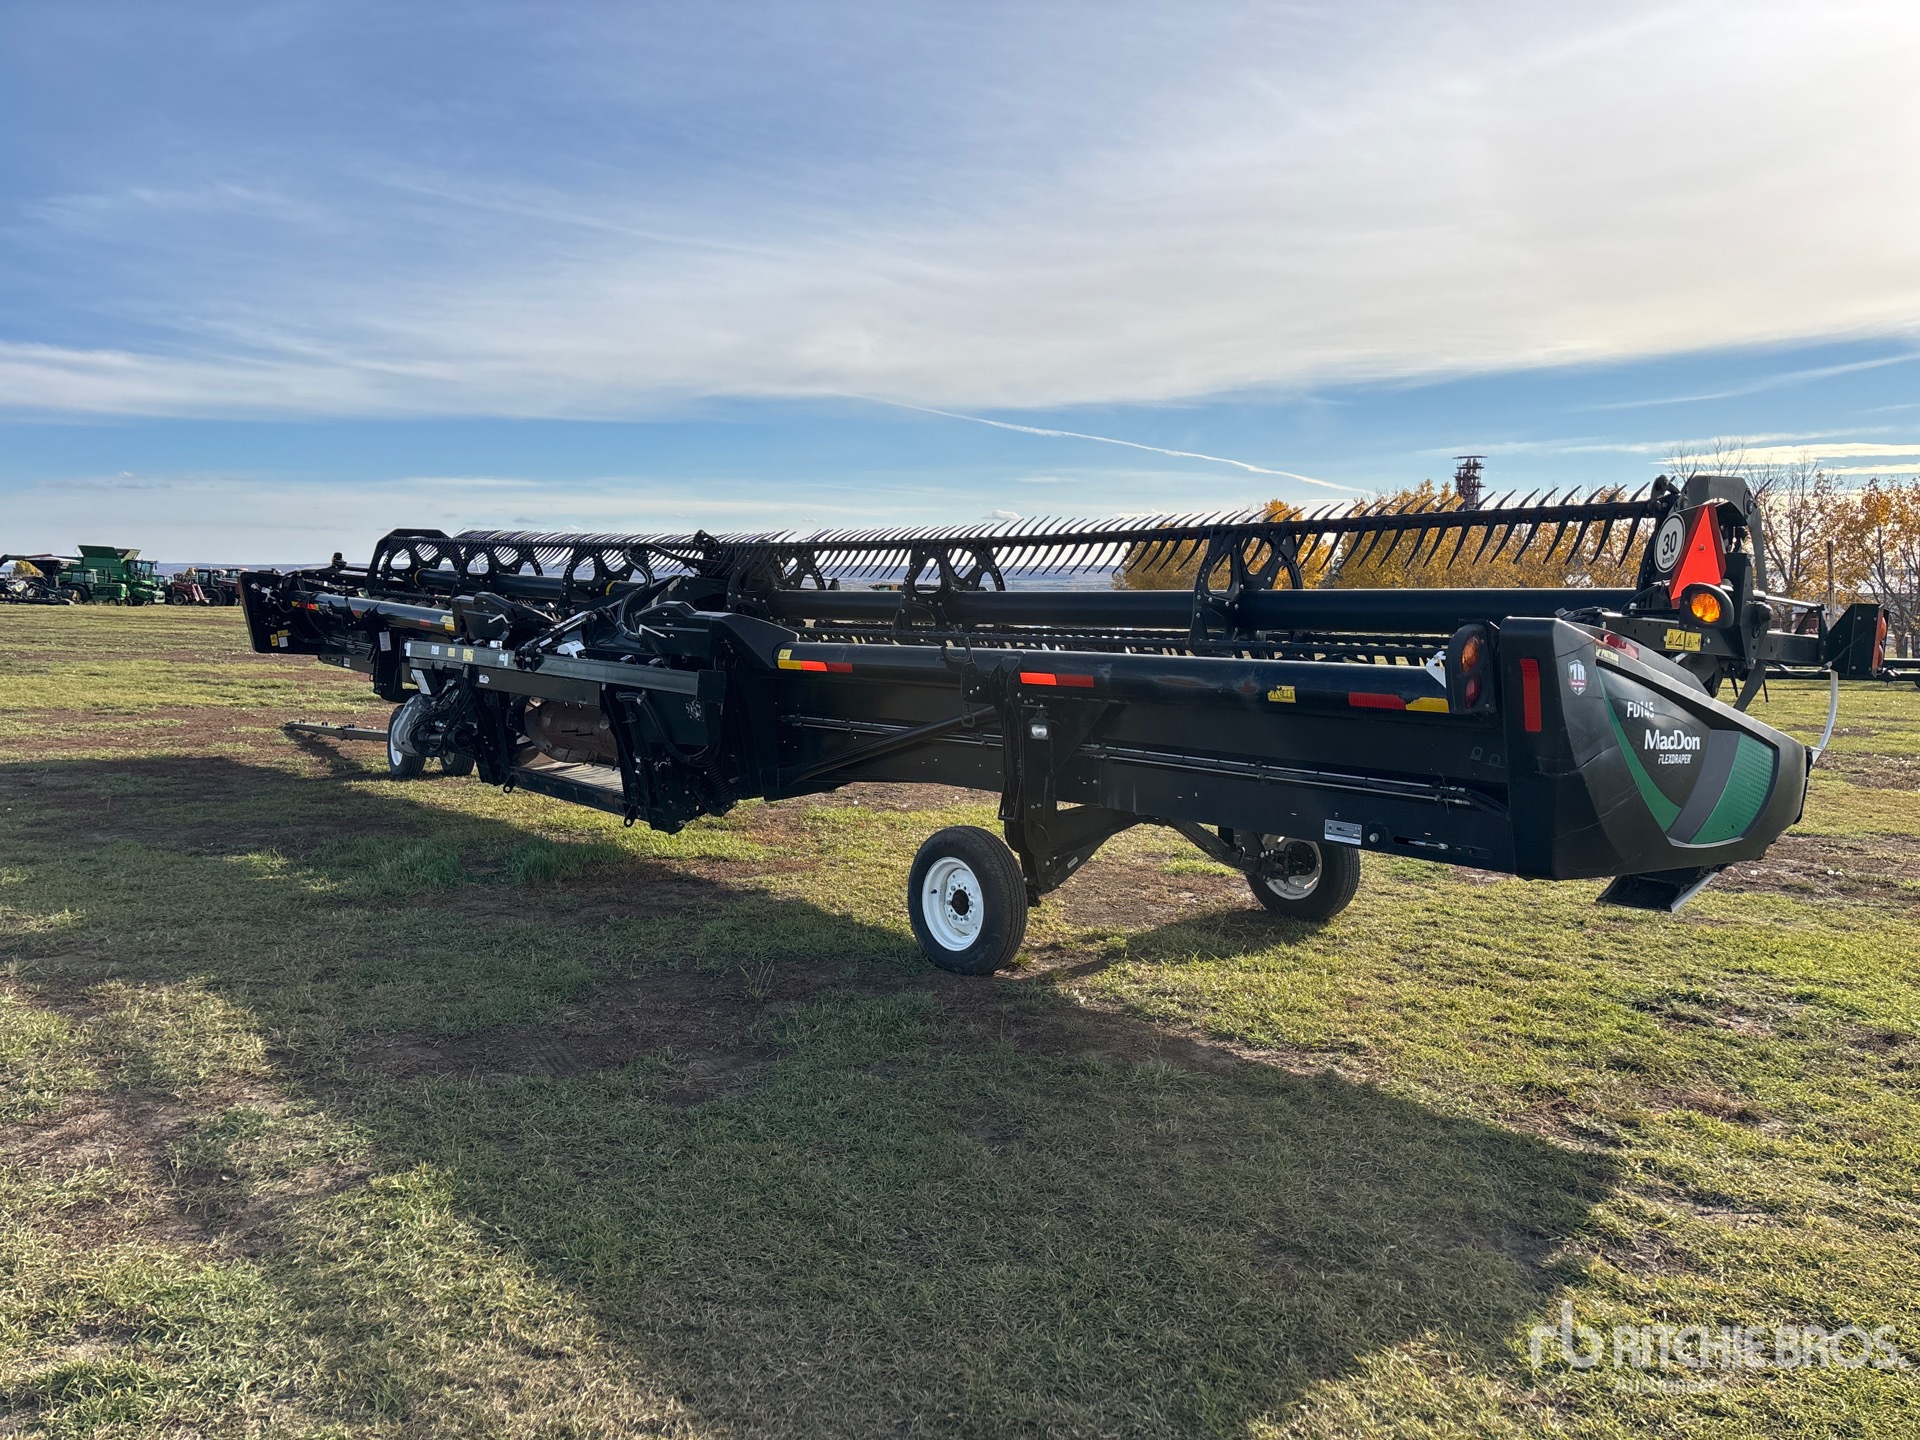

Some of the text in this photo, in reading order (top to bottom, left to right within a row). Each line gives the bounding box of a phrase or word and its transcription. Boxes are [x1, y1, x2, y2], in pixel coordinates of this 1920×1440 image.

[1662, 530, 1677, 556] 30
[1626, 701, 1655, 718] FD145
[1644, 729, 1701, 750] MacDon
[1657, 753, 1693, 765] FLEXDRAPER
